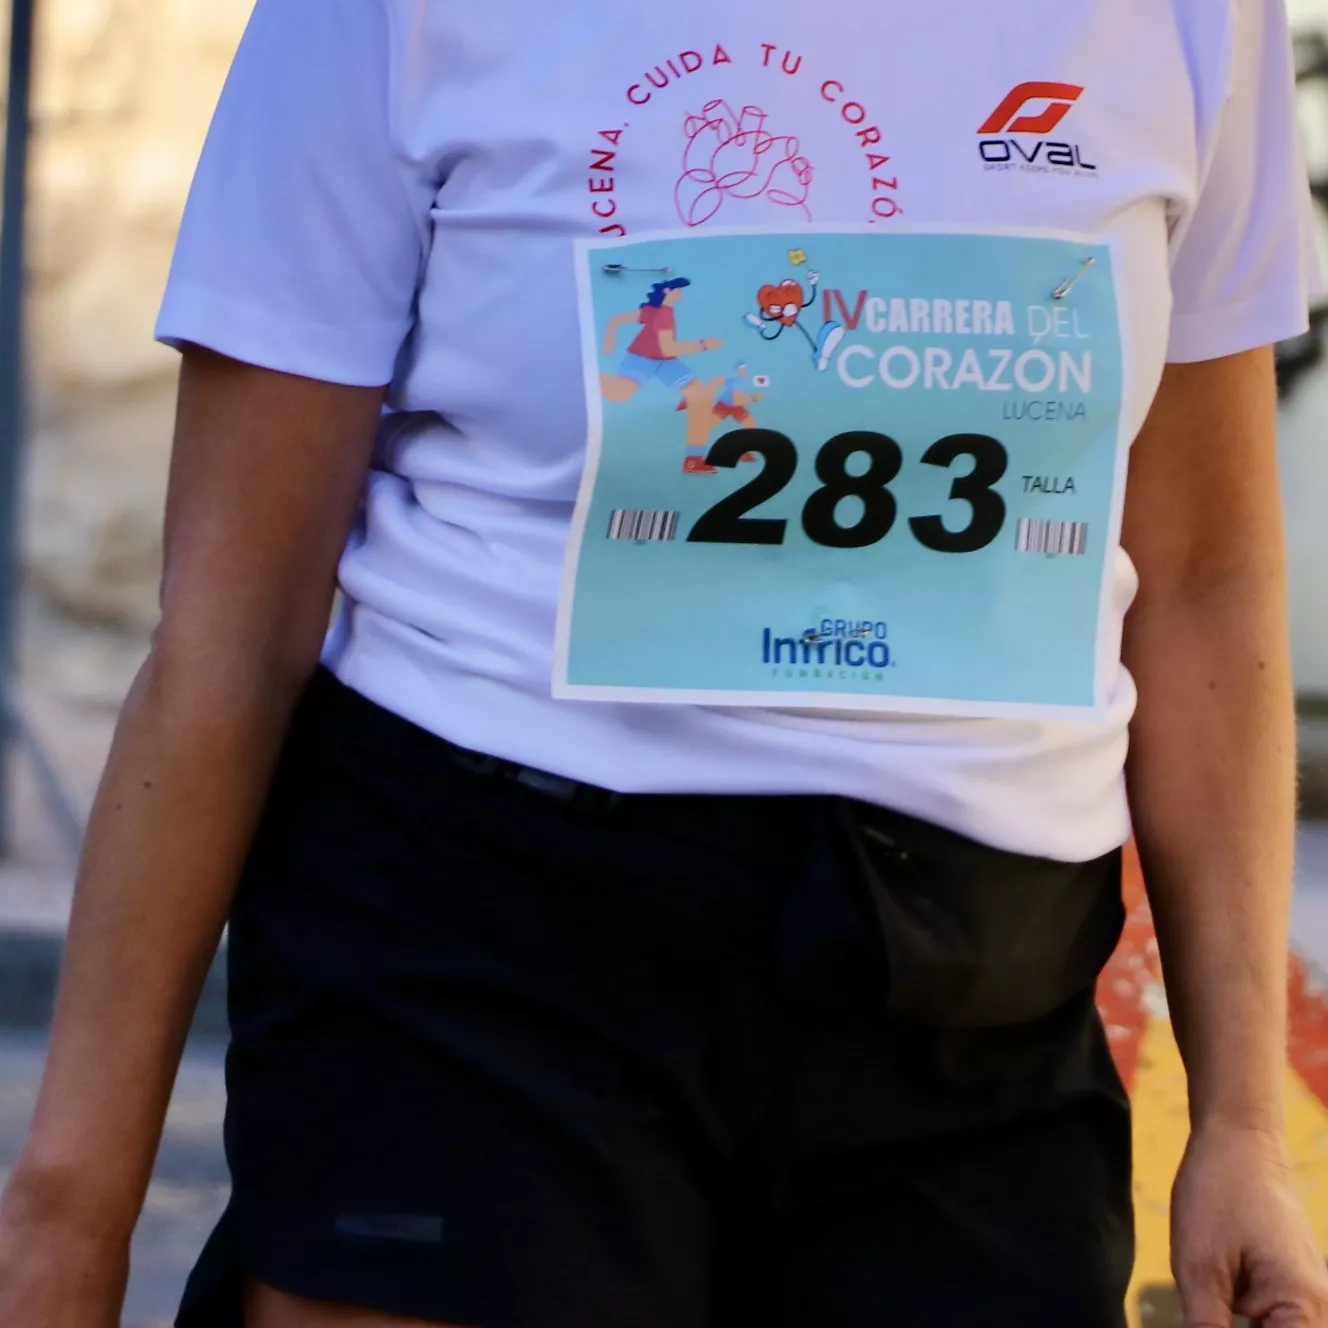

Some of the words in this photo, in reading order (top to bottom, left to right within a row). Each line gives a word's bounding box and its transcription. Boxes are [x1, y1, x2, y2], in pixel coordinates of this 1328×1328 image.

[626, 43, 732, 105] CUIDA
[761, 43, 803, 75] TU
[820, 79, 904, 224] CORAZÓ
[822, 288, 868, 331] IV
[865, 296, 1016, 336] CARRERA
[1027, 304, 1091, 340] DEL
[1002, 399, 1088, 422] LUCENA
[686, 428, 1010, 554] 283
[1022, 475, 1077, 494] TALLA
[821, 618, 888, 640] GRUPO
